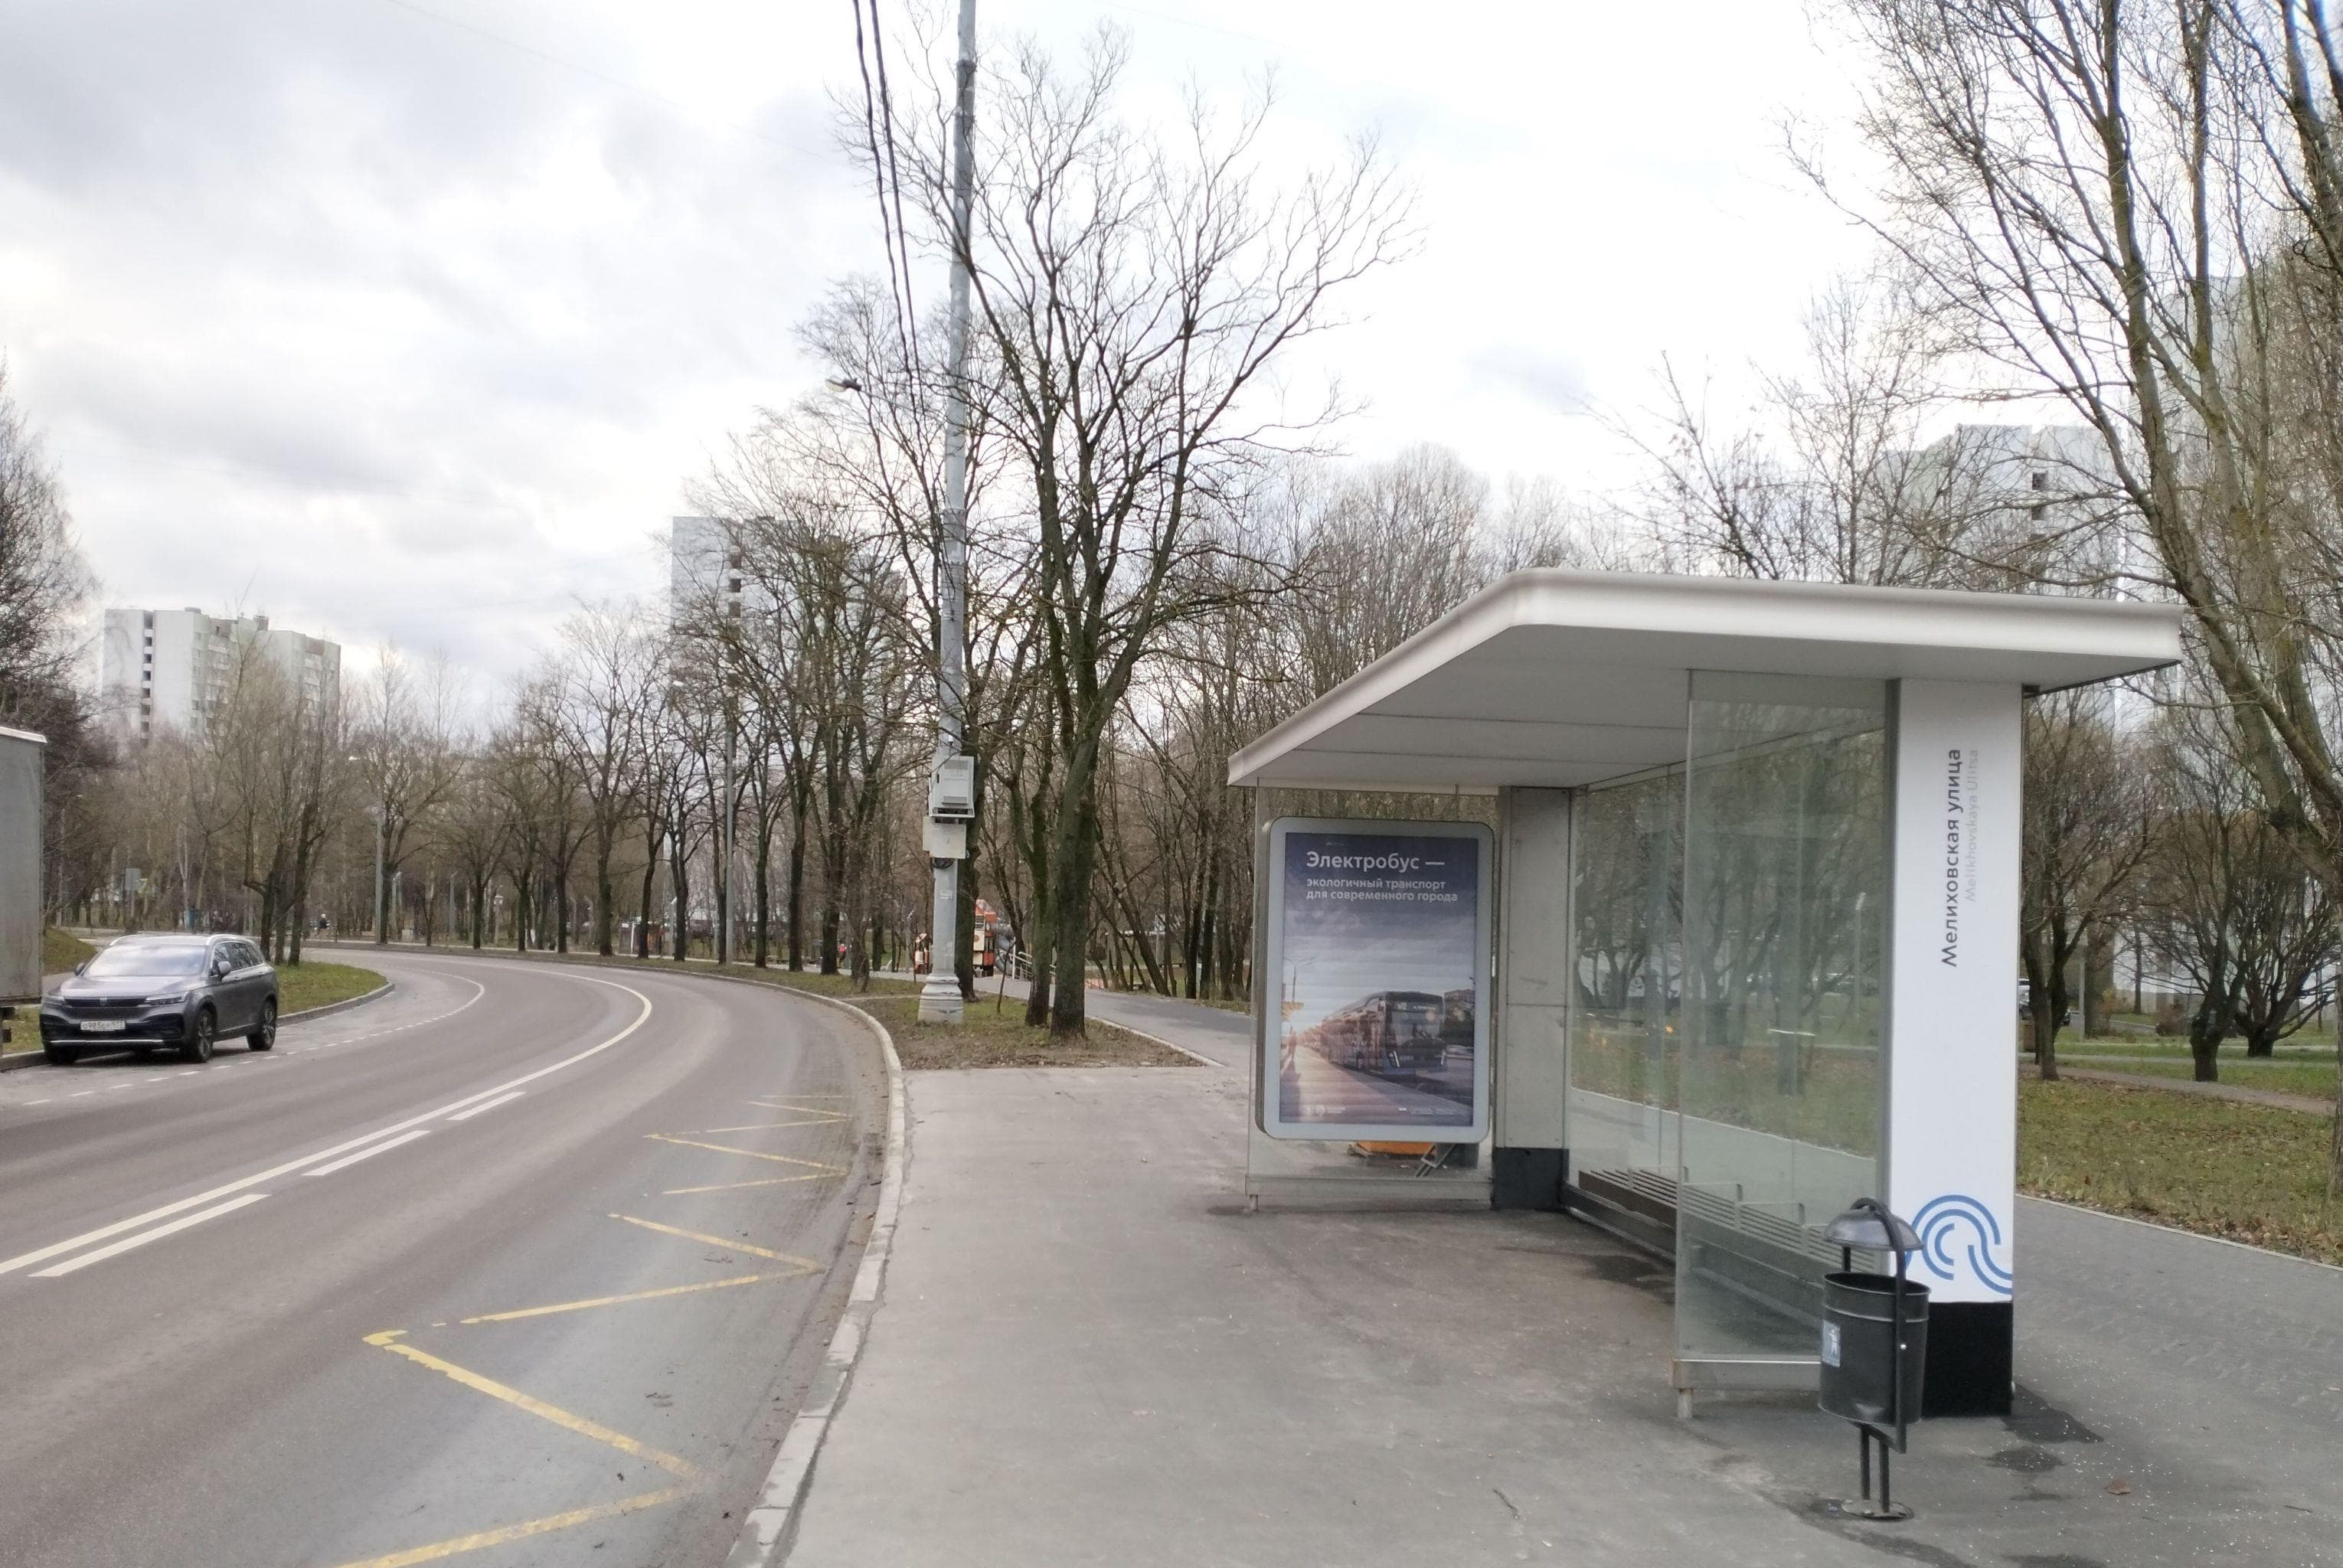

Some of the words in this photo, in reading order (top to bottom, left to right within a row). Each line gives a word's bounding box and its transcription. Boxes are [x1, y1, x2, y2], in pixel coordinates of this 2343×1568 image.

[1947, 749, 1964, 813] улица
[1306, 851, 1420, 873] Электробус
[1965, 795, 1979, 902] Melikhovskaya
[1306, 878, 1383, 888] экологичный
[1386, 880, 1446, 890] транспорт
[1306, 890, 1328, 900] для
[1331, 890, 1414, 902] современного
[1417, 892, 1458, 903] города
[1941, 819, 1959, 967] Мелиховская
